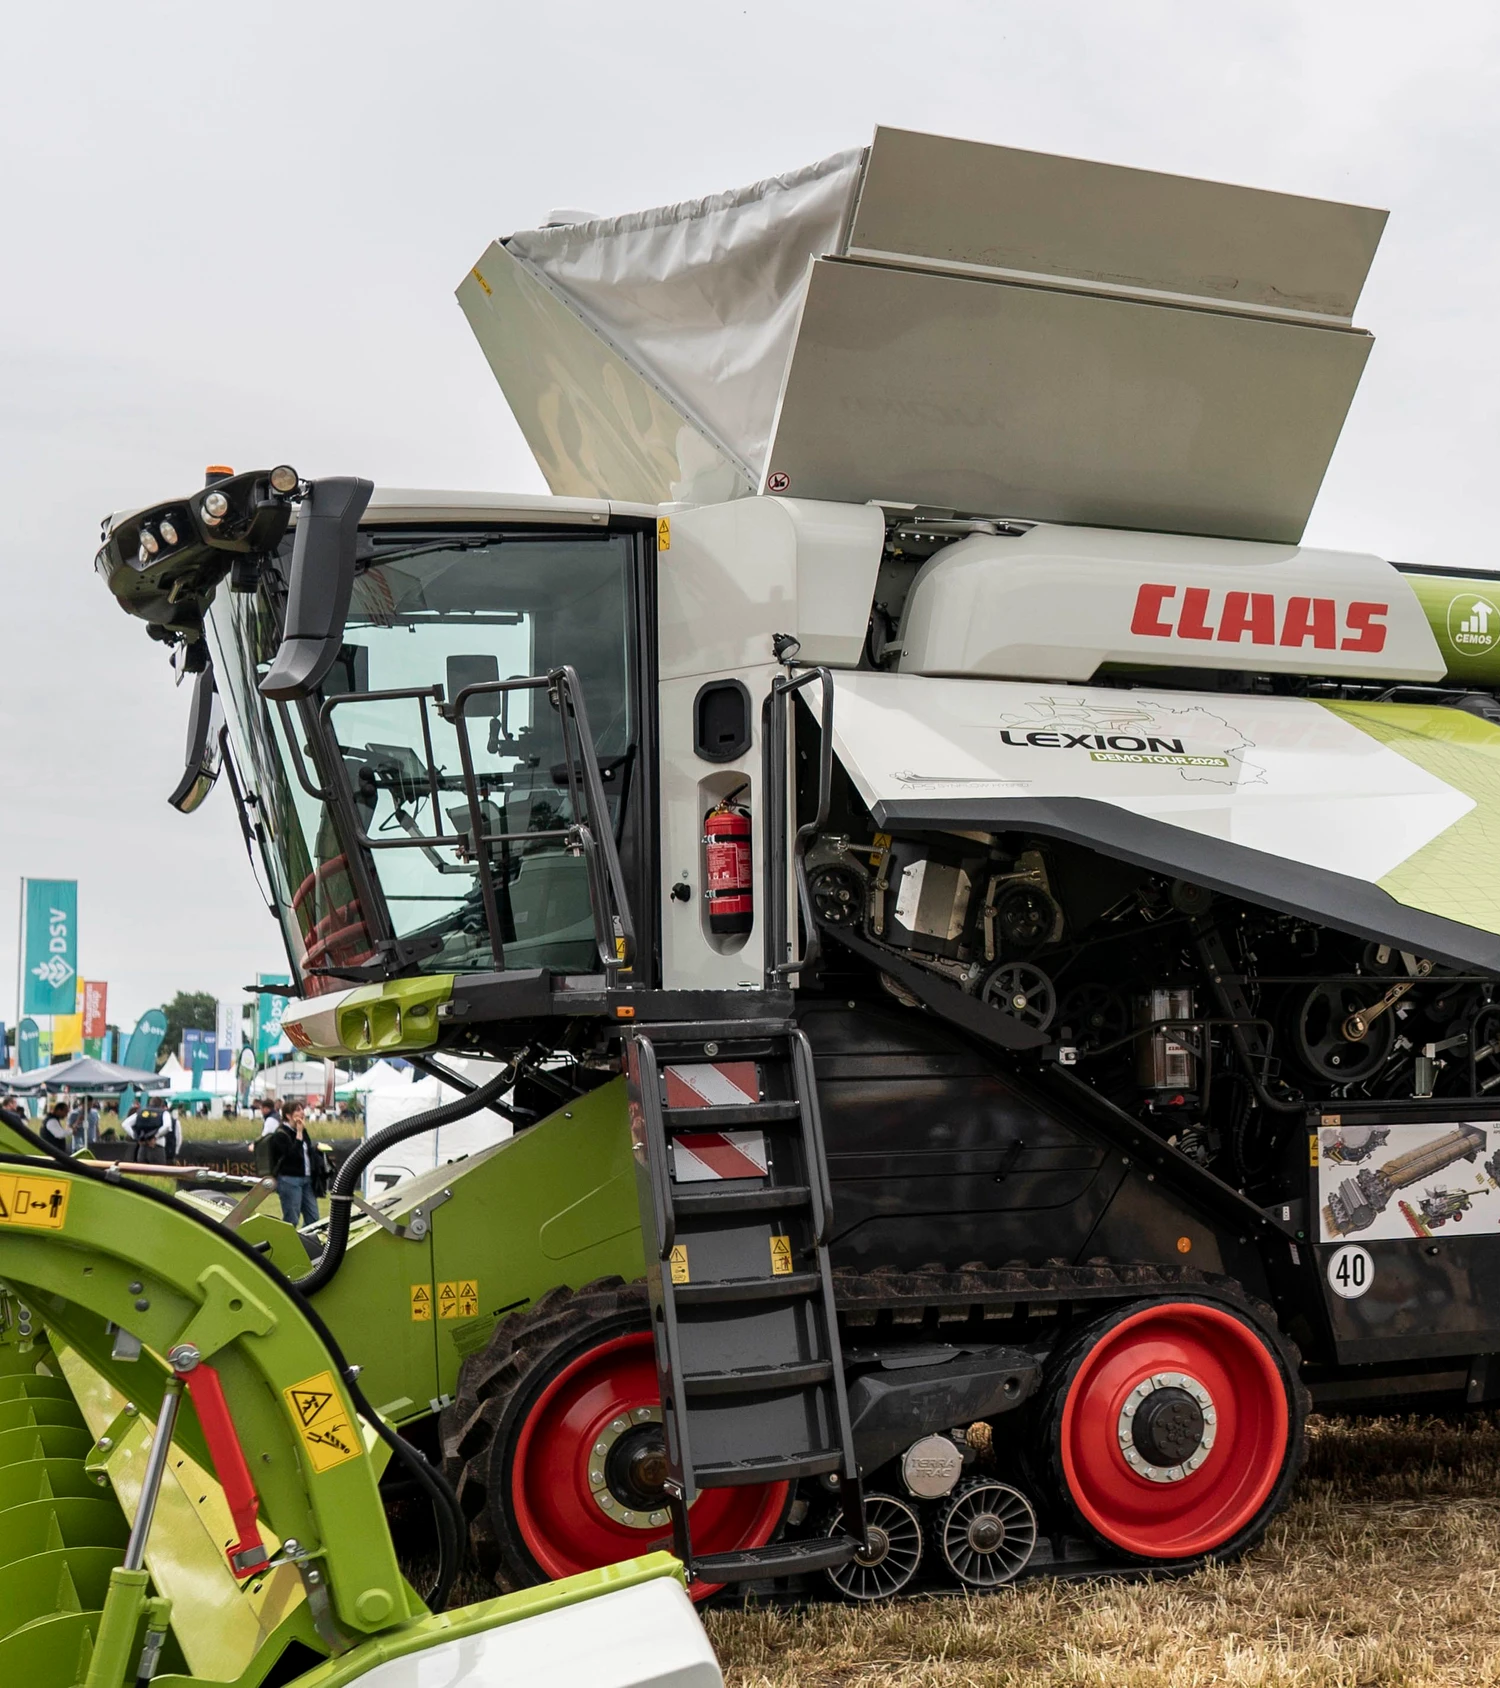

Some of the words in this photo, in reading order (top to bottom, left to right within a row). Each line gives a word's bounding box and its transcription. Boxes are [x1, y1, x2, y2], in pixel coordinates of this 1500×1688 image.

[1131, 583, 1388, 653] CLAAS
[1456, 634, 1492, 645] CEMOS
[1000, 731, 1185, 753] LEXION
[1095, 753, 1143, 763] DEMO
[1142, 755, 1188, 765] TOUR
[50, 907, 67, 953] DSV
[1336, 1254, 1365, 1287] 40
[912, 1458, 955, 1468] TERRA
[916, 1467, 952, 1478] TRAC
